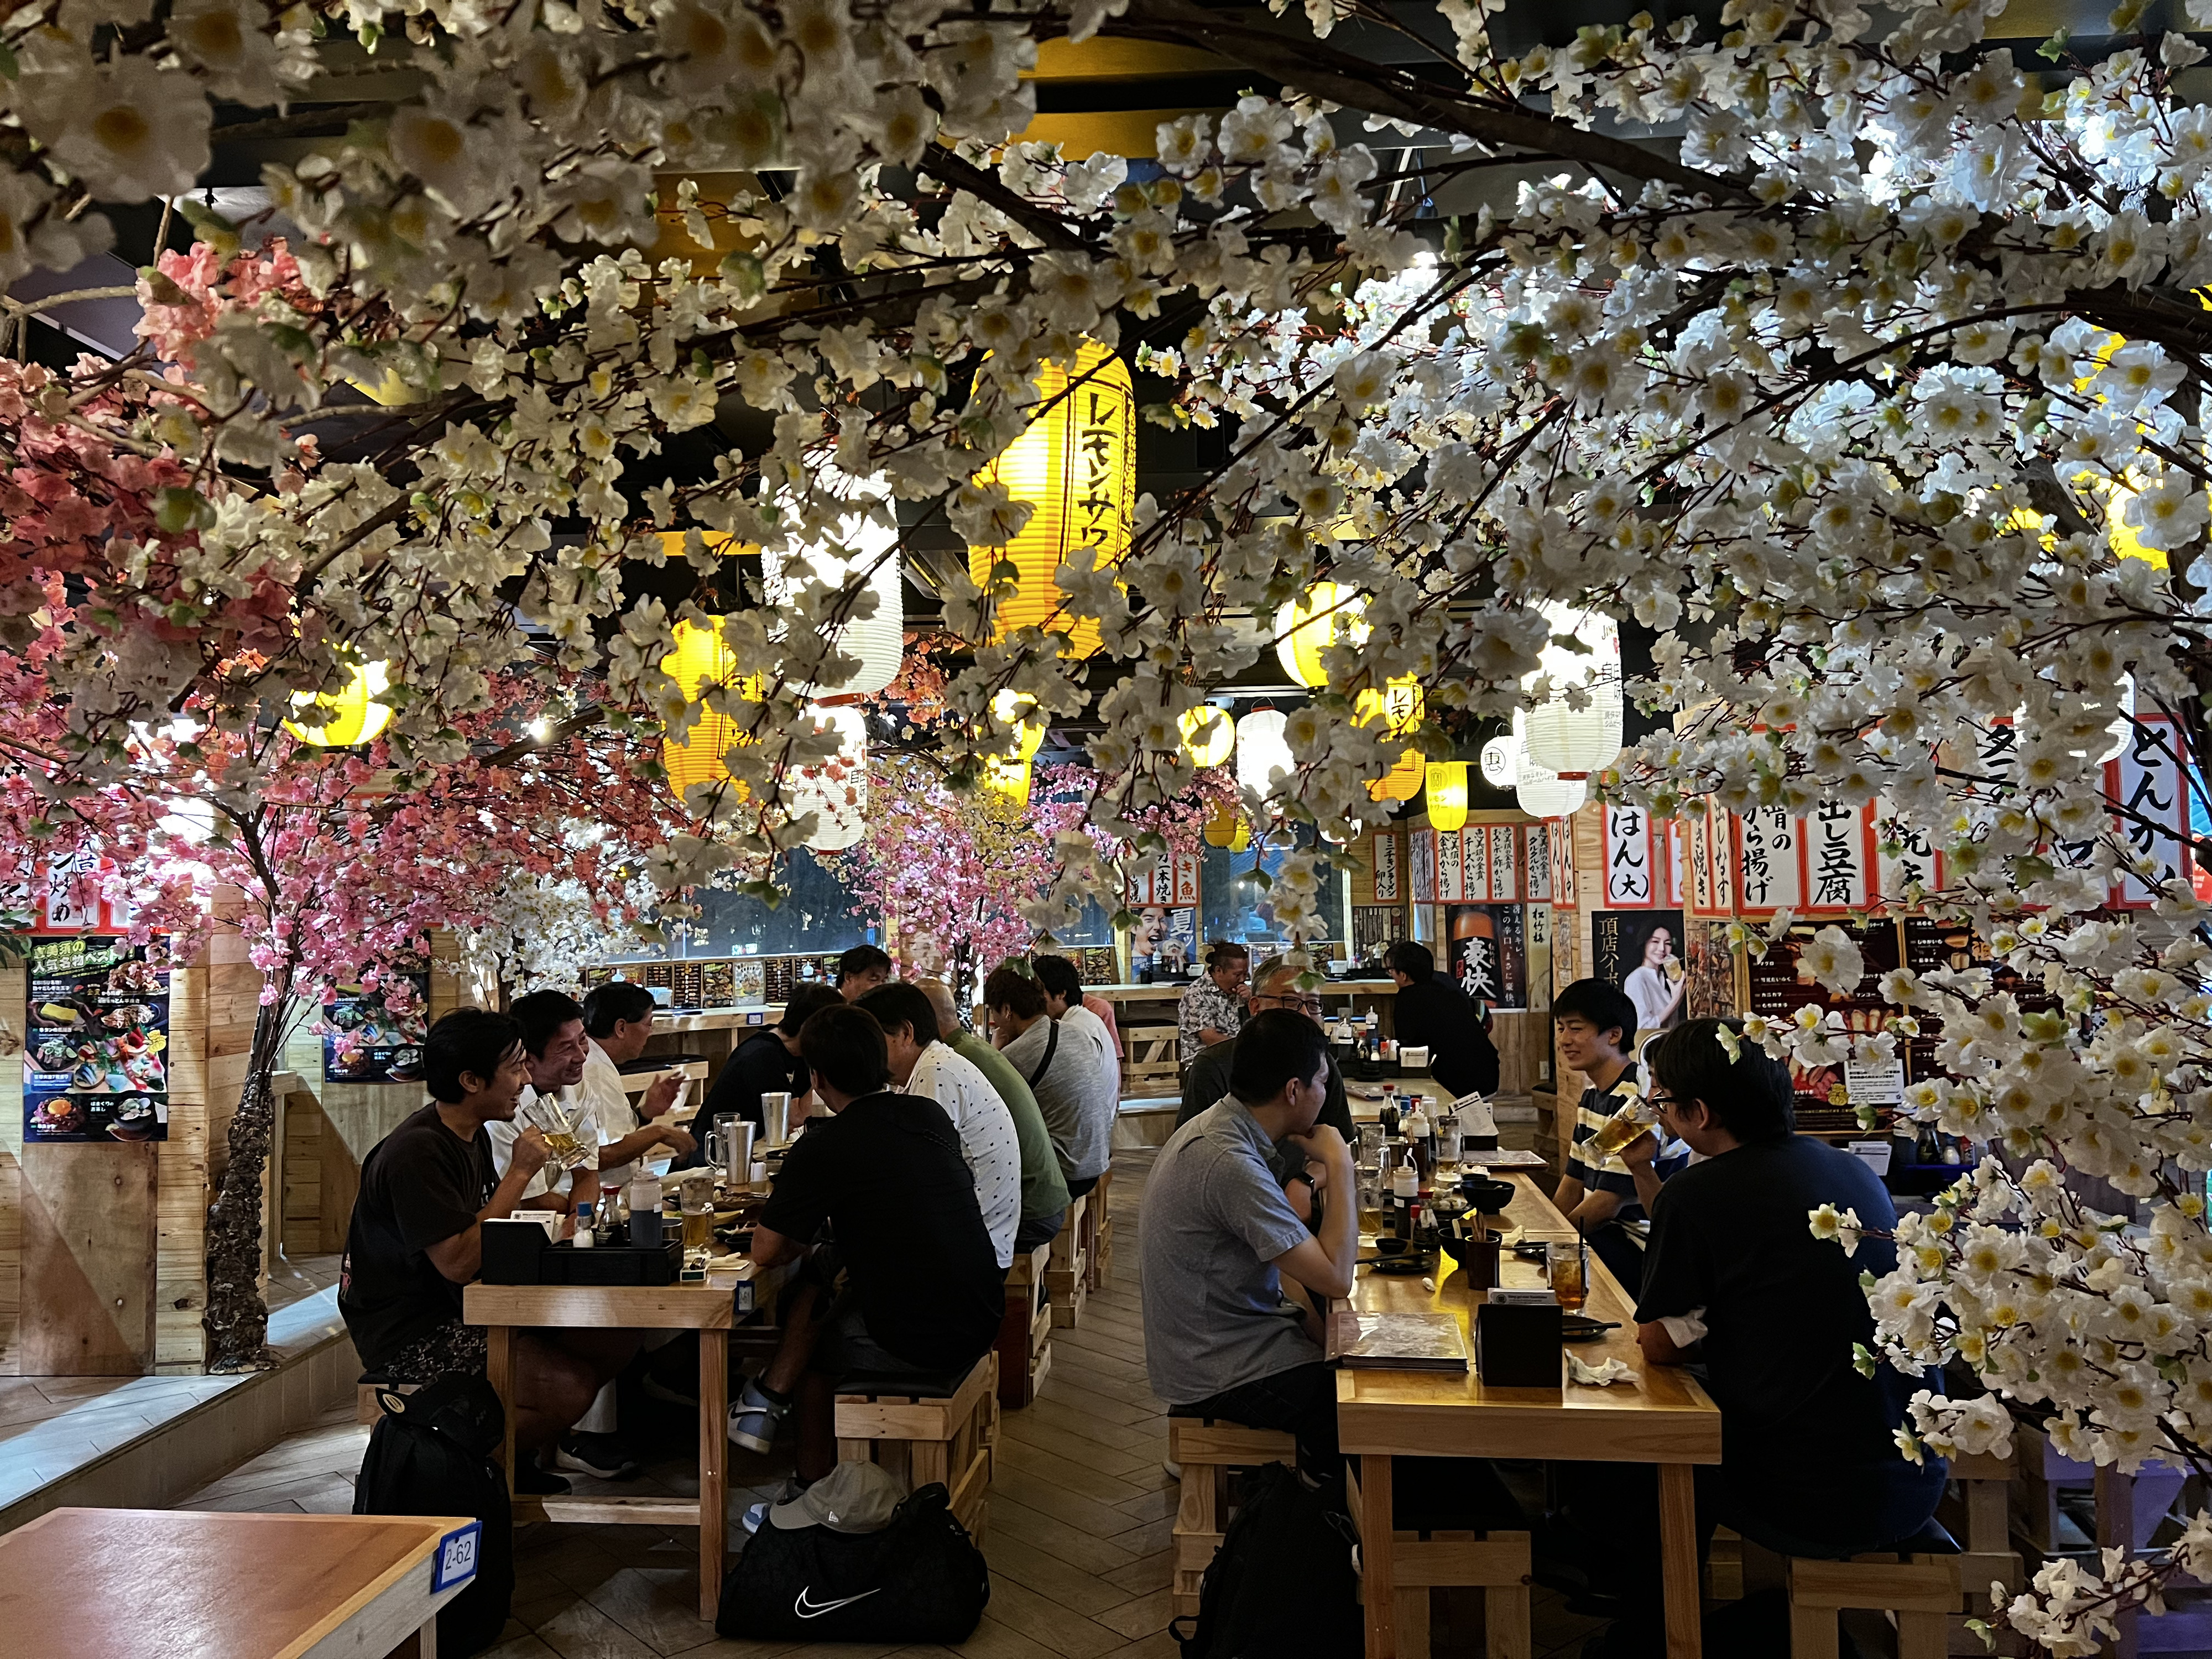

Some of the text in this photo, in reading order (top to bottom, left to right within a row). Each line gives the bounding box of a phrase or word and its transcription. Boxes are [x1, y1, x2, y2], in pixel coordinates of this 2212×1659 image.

[1609, 803, 1649, 900] はん(大)
[1460, 937, 1496, 998] 豪快
[445, 1541, 471, 1571] 2-62
